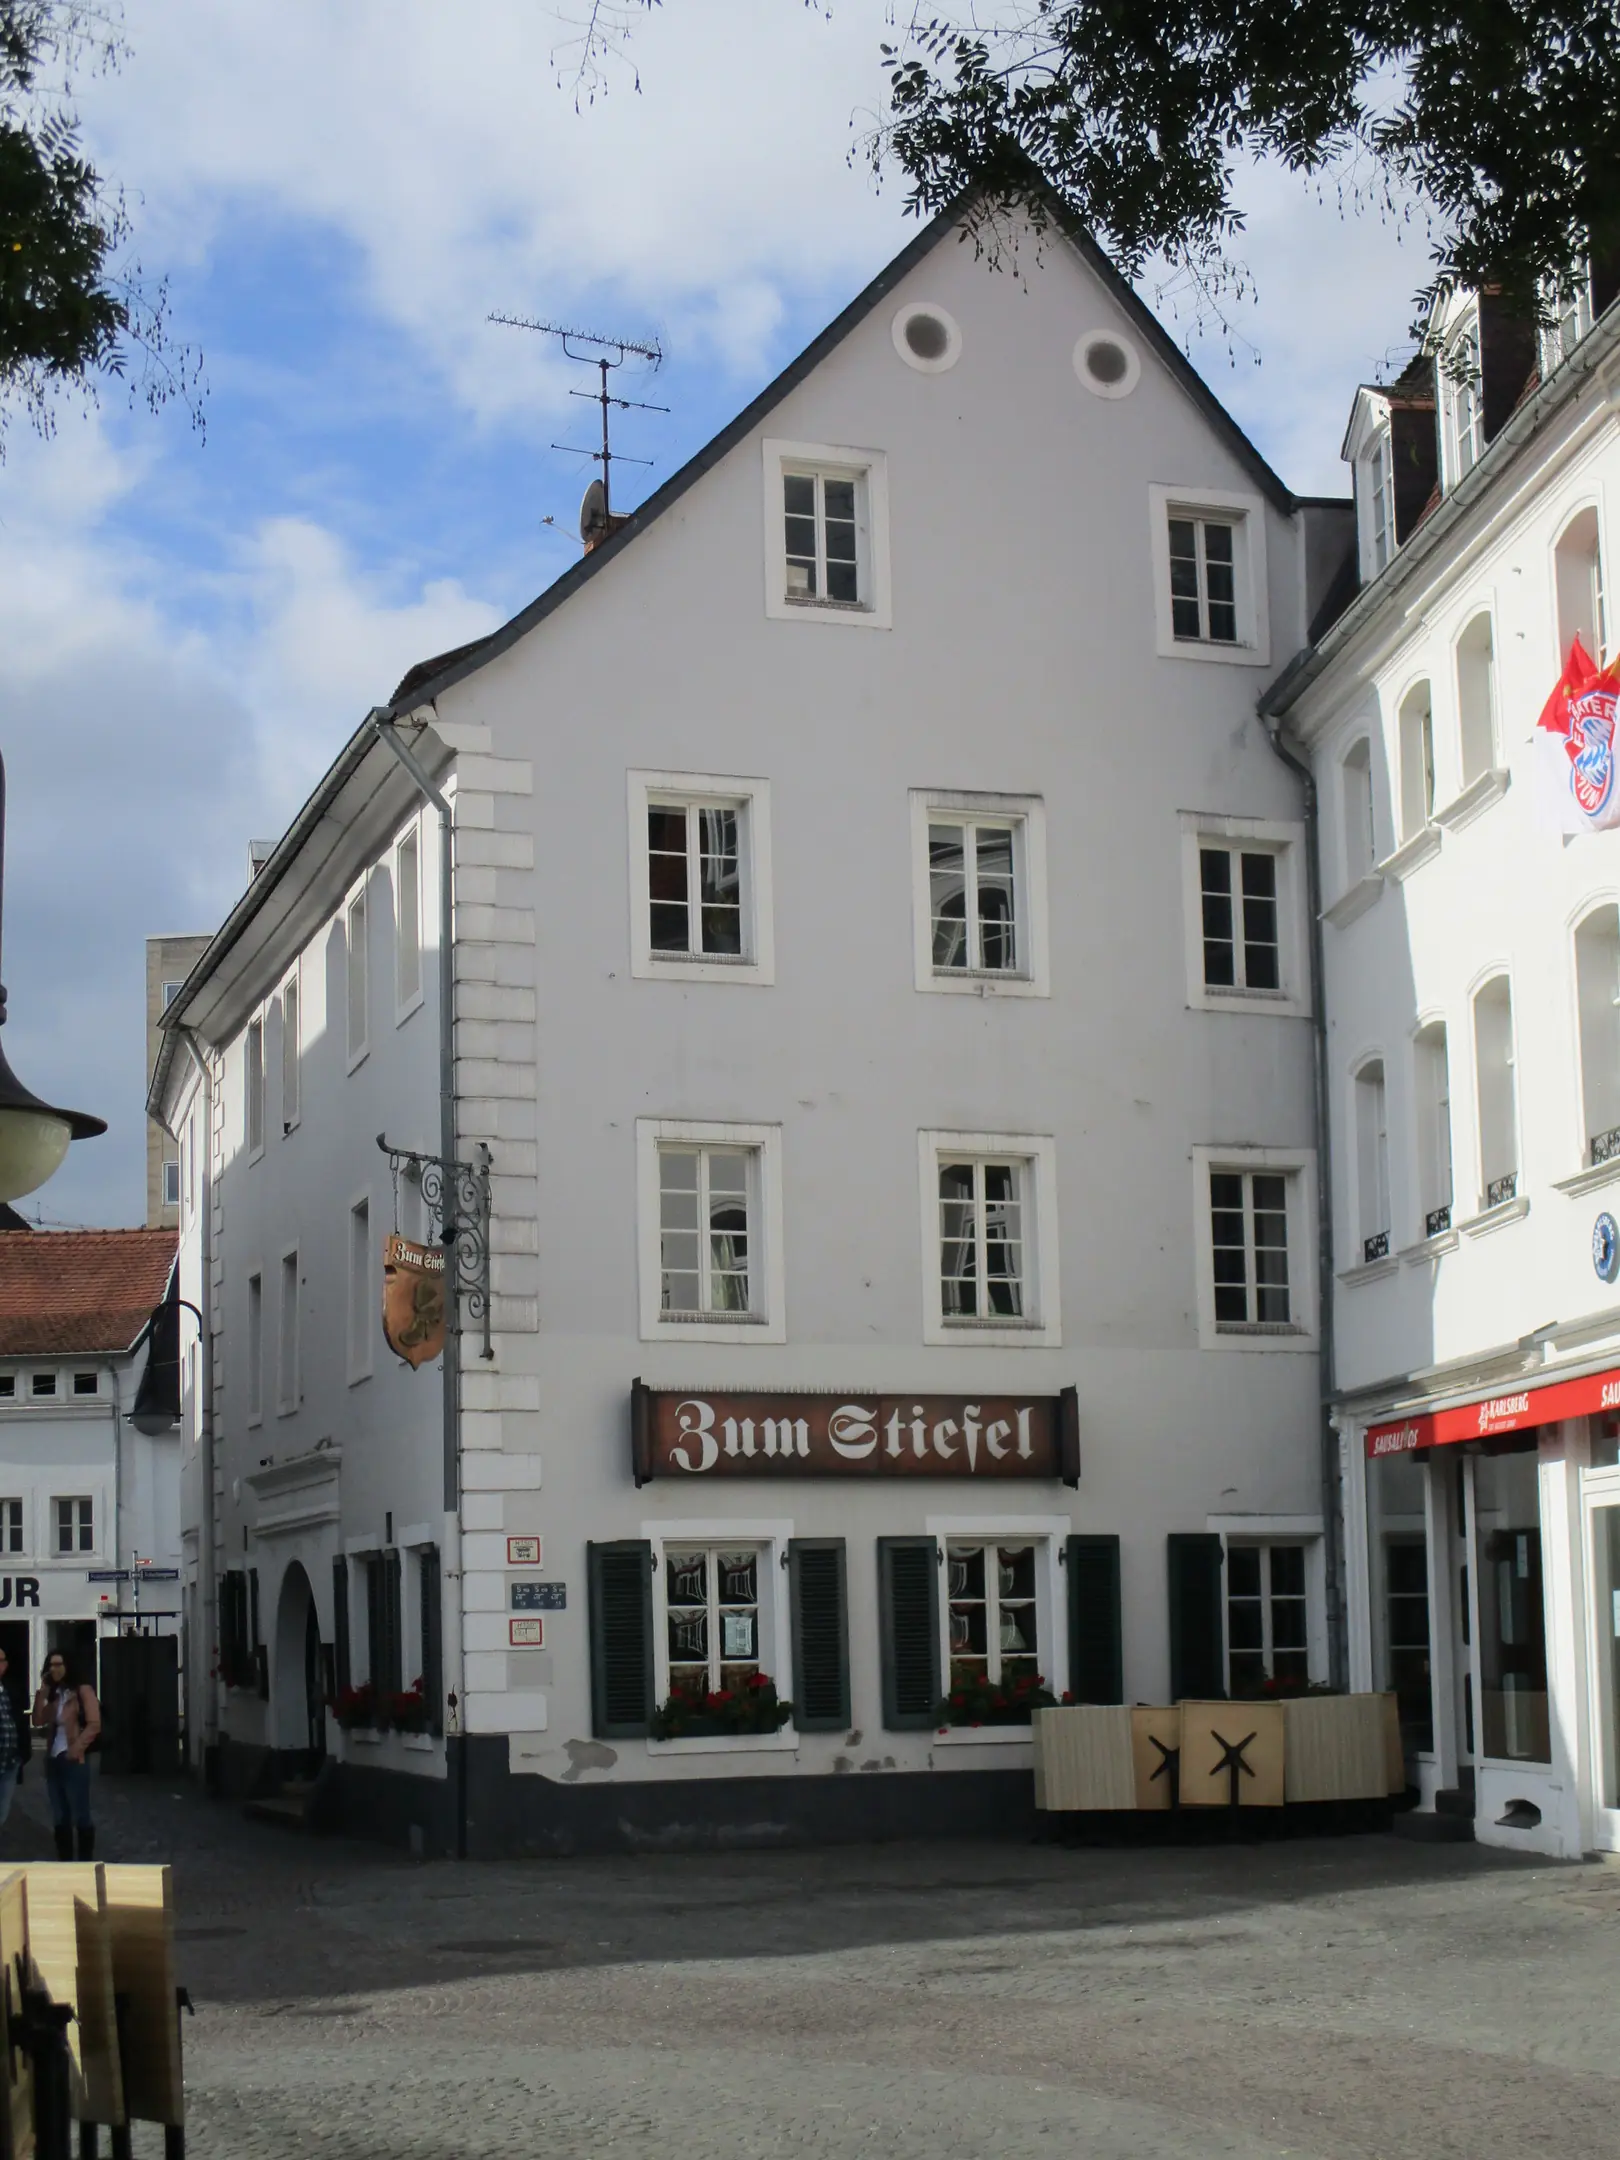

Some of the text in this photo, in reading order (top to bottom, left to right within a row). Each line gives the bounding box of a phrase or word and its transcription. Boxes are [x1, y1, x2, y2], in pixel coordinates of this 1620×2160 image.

[394, 1242, 422, 1266] Zum
[1490, 1392, 1529, 1419] KARLSBERG
[669, 1400, 1034, 1473] Zum Stiefel
